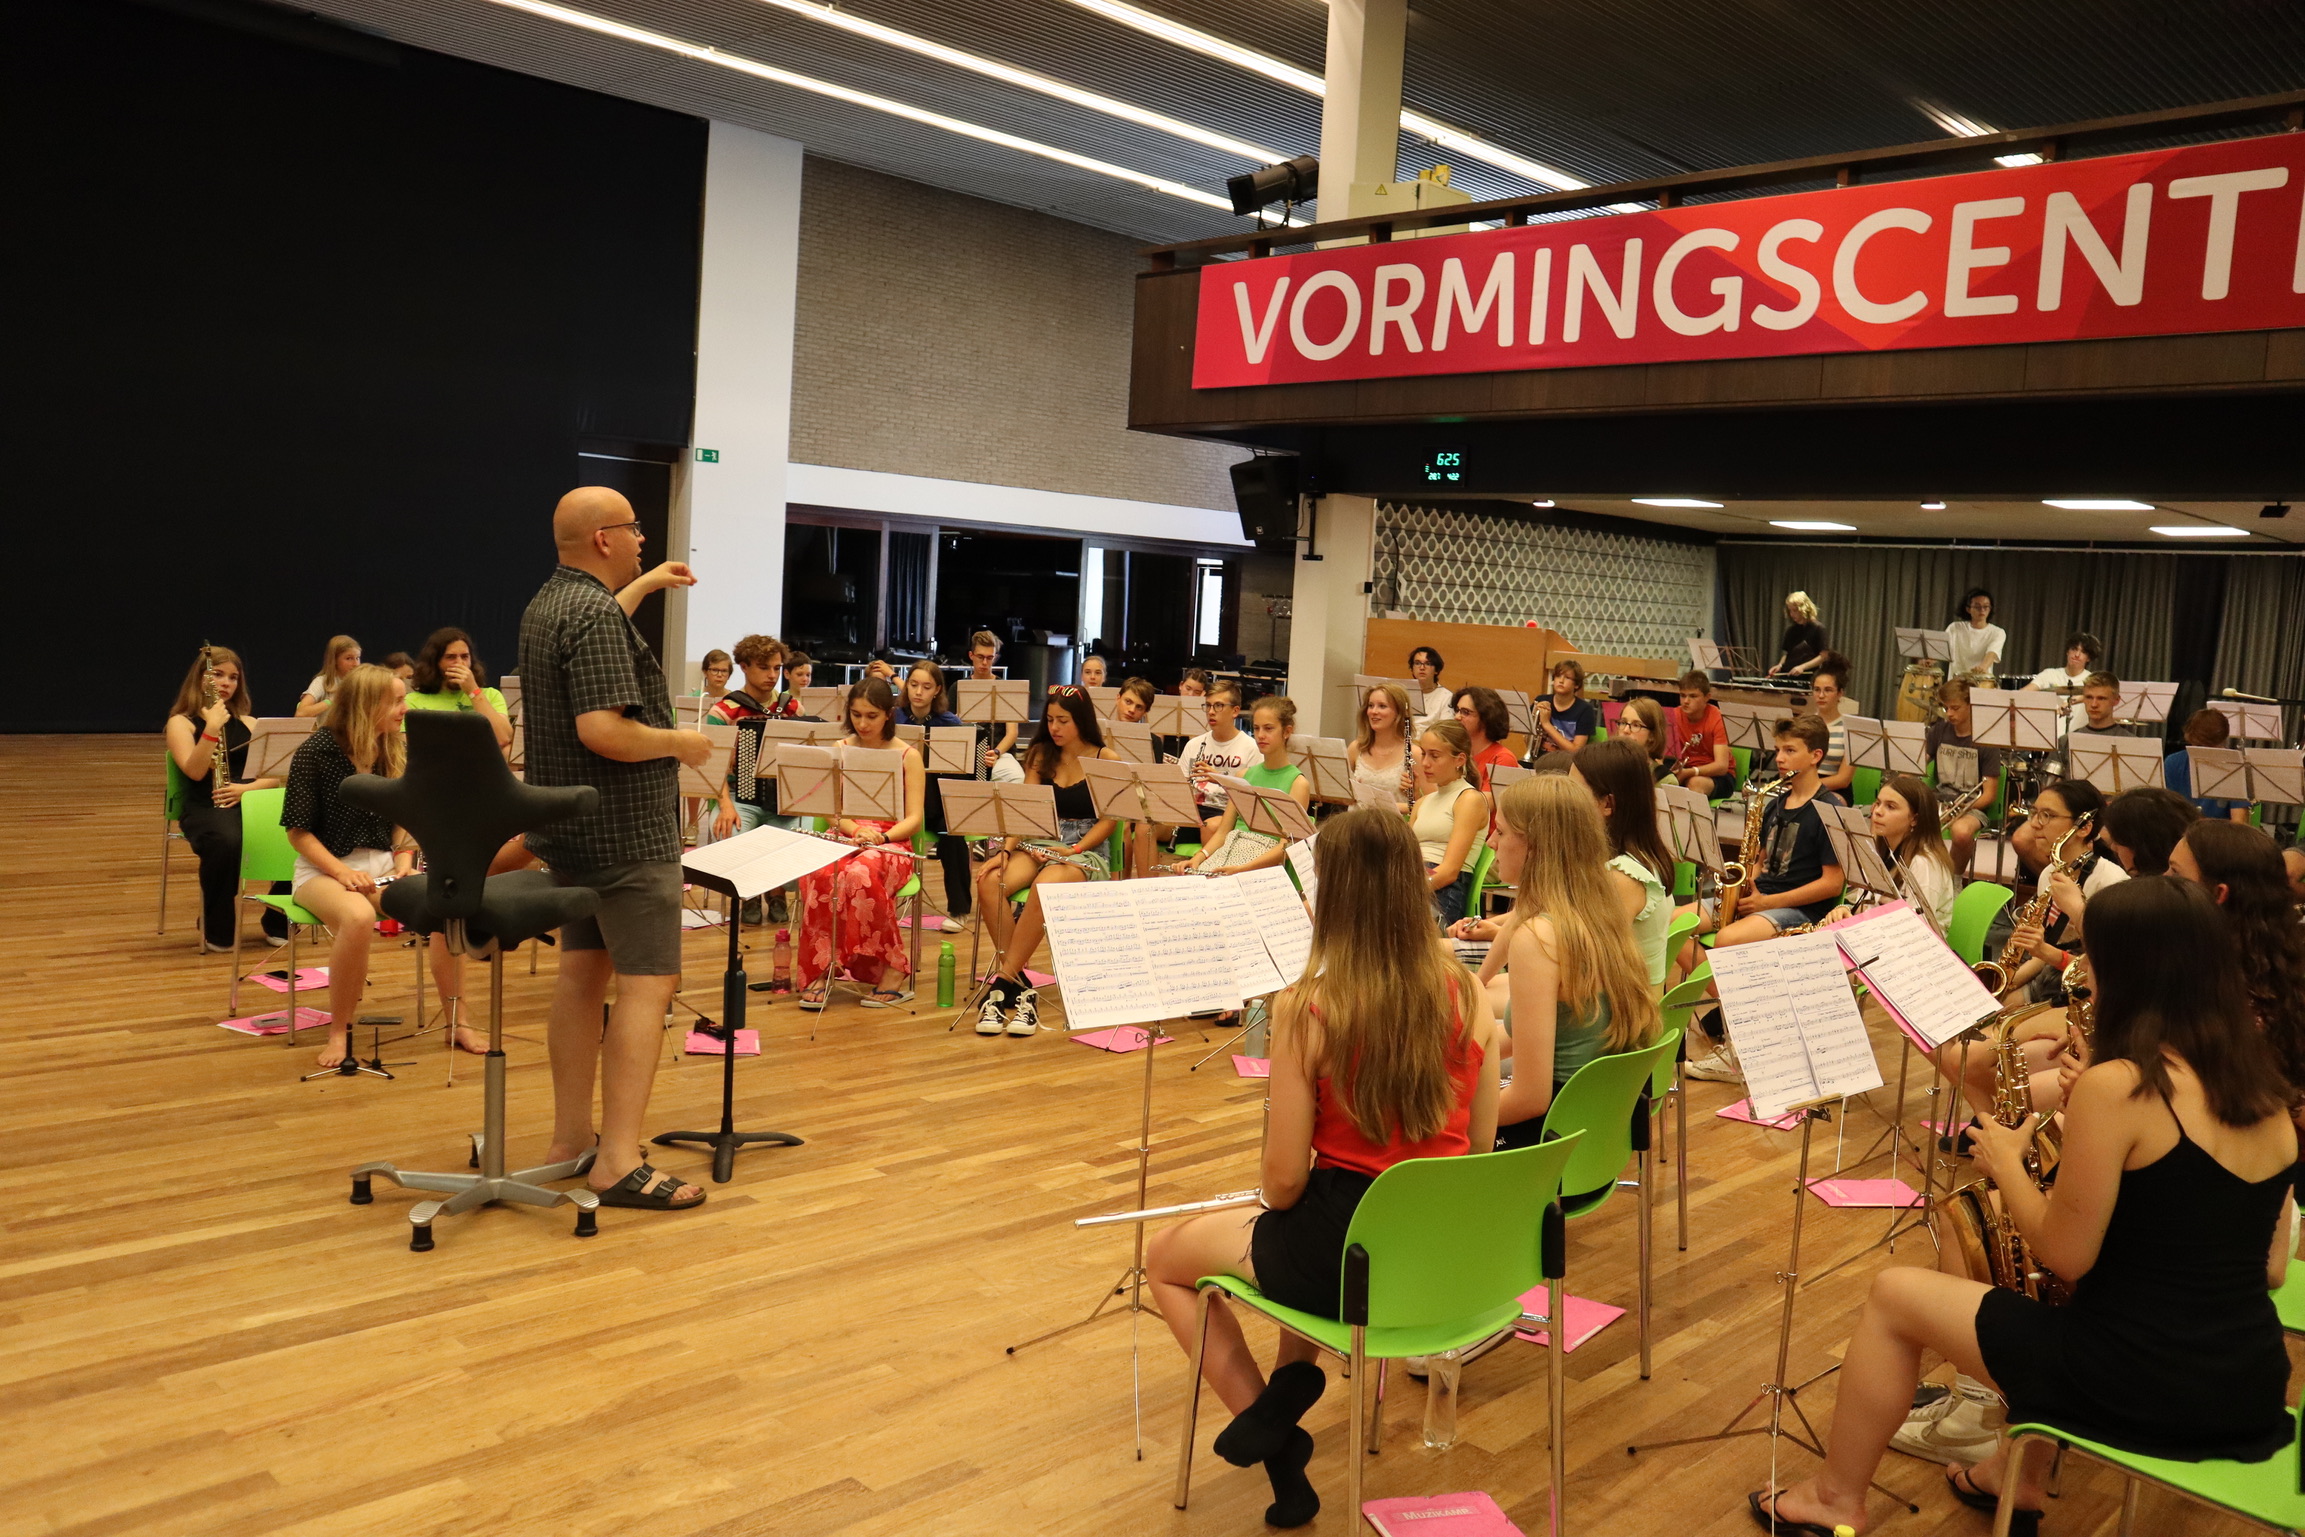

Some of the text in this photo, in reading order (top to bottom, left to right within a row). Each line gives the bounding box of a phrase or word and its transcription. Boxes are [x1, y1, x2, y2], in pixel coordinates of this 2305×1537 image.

[1232, 166, 2305, 365] VORMINGSCENT
[1436, 452, 1460, 466] 625
[1957, 749, 1978, 760] SHOP
